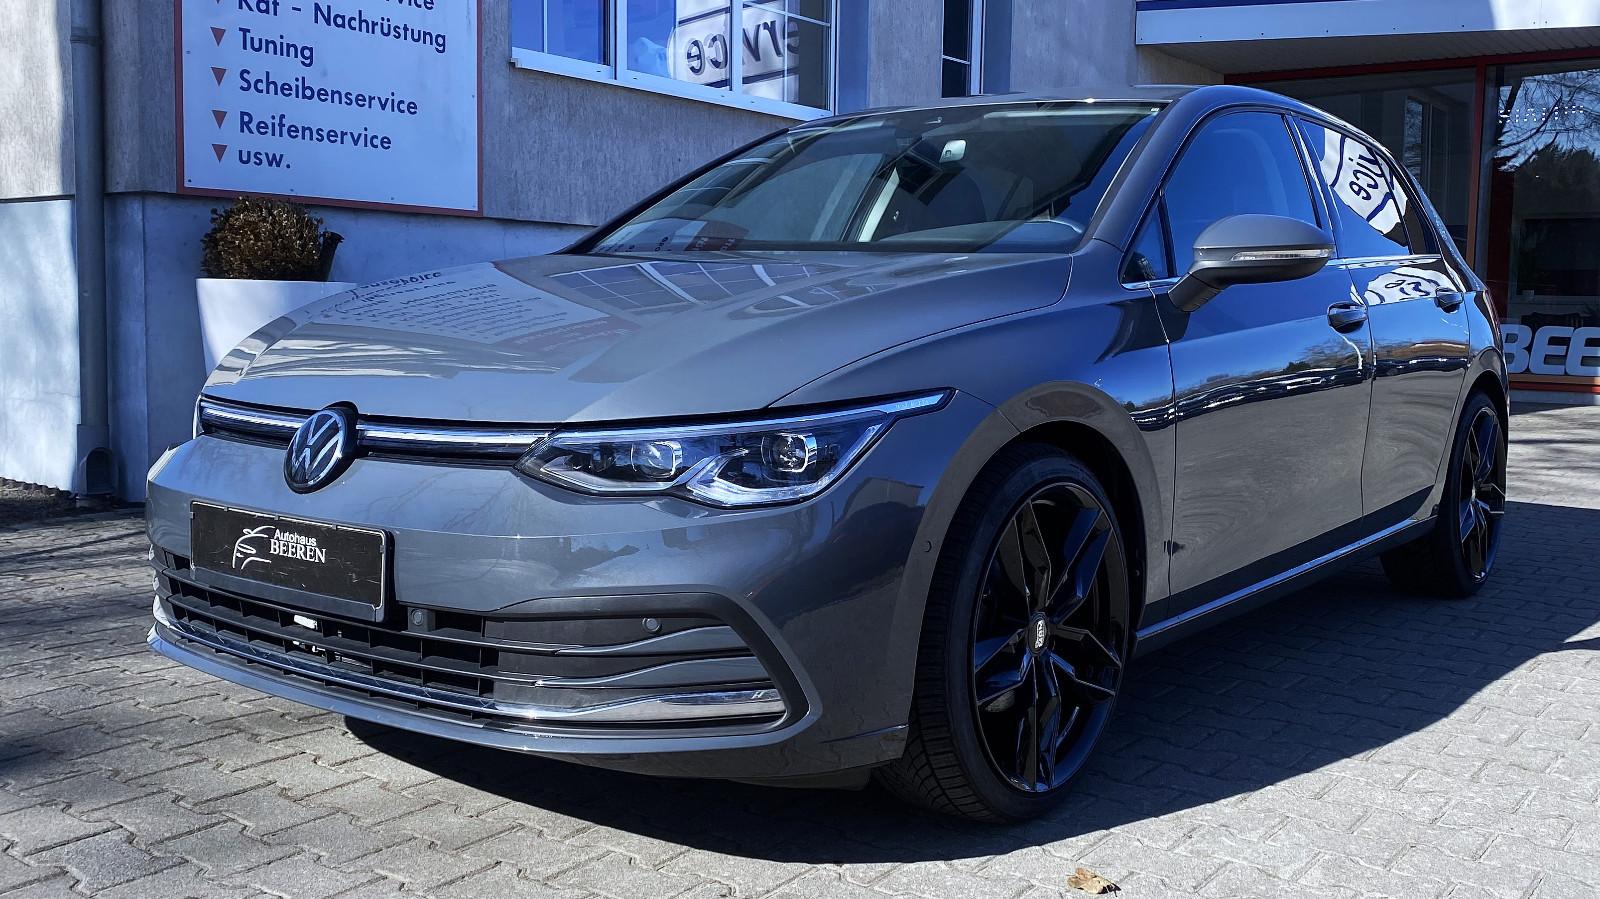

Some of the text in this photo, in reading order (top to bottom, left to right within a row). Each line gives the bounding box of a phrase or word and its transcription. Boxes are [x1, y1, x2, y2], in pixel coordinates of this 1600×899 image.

[238, 27, 314, 67] Tuning
[313, 2, 446, 54] Nachrüstung
[239, 69, 418, 116] Scheibenservice
[239, 111, 392, 150] Reifenservice
[238, 149, 291, 169] usw.
[269, 538, 327, 564] BEEREN
[273, 528, 317, 547] Autohaus
